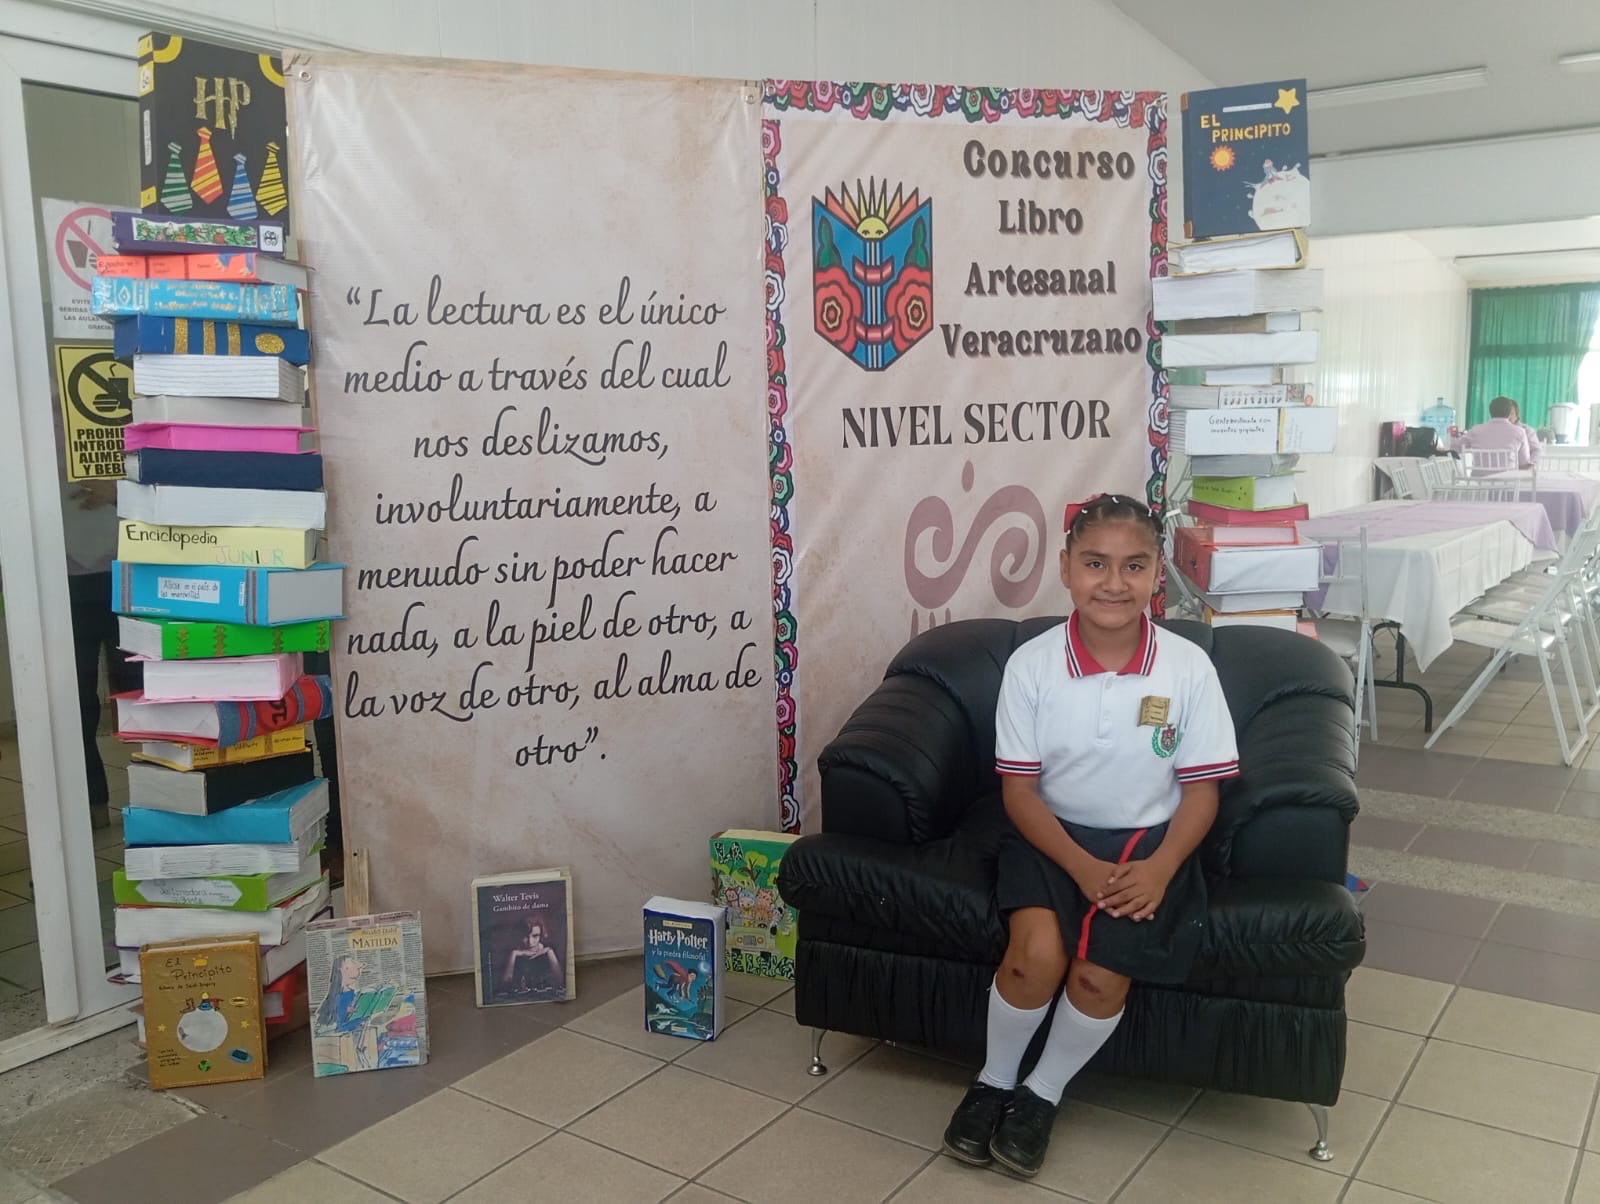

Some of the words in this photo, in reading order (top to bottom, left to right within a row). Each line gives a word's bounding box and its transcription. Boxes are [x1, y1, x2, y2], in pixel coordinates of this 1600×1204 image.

[193, 76, 251, 139] HP
[1200, 114, 1221, 129] EL
[1211, 122, 1292, 143] PRINCIPITO
[963, 139, 1136, 178] Concurso
[998, 198, 1084, 235] Libro
[963, 260, 1118, 297] Artesanal
[426, 273, 551, 326] lectura
[556, 303, 586, 326] es
[598, 275, 635, 326] el
[640, 290, 727, 326] único
[939, 323, 1143, 358] Veracruzano
[343, 339, 453, 394] medio
[457, 369, 483, 392] a
[487, 355, 588, 392] través
[600, 338, 656, 390] del
[661, 340, 732, 389] cual
[413, 434, 469, 459] nos
[481, 405, 669, 467] deslizamos,
[841, 404, 953, 449] NIVEL
[963, 399, 1112, 445] SECTOR
[74, 439, 125, 452] INTROD
[79, 451, 125, 464] ALIME
[83, 464, 91, 475] Y
[95, 463, 126, 475] BEBI
[375, 472, 681, 525] involuntariamente,
[694, 491, 718, 513] a
[126, 524, 218, 550] Enciclopedia
[211, 545, 286, 566] JUNIOR
[357, 535, 490, 591] menudo
[494, 551, 547, 584] sin
[545, 529, 647, 609] poder
[651, 525, 739, 576] hacer
[347, 601, 439, 657] nada,
[453, 627, 479, 649] a
[485, 598, 526, 647] la
[523, 593, 597, 674] piel
[602, 589, 643, 639] de
[647, 603, 718, 641] otro,
[730, 609, 753, 631] a
[344, 670, 386, 719] la
[389, 690, 474, 723] voz
[458, 660, 501, 711] de
[506, 673, 580, 711] otro,
[593, 652, 633, 700] al
[637, 648, 720, 697] alma
[724, 641, 763, 690] de
[493, 893, 518, 902] Walter
[520, 892, 539, 901] Tevis
[493, 904, 521, 912] Gambito
[352, 937, 398, 949] MATILDA
[648, 929, 676, 946] Harry
[676, 929, 708, 950] Potter
[165, 957, 182, 968] El
[170, 965, 232, 981] Principito
